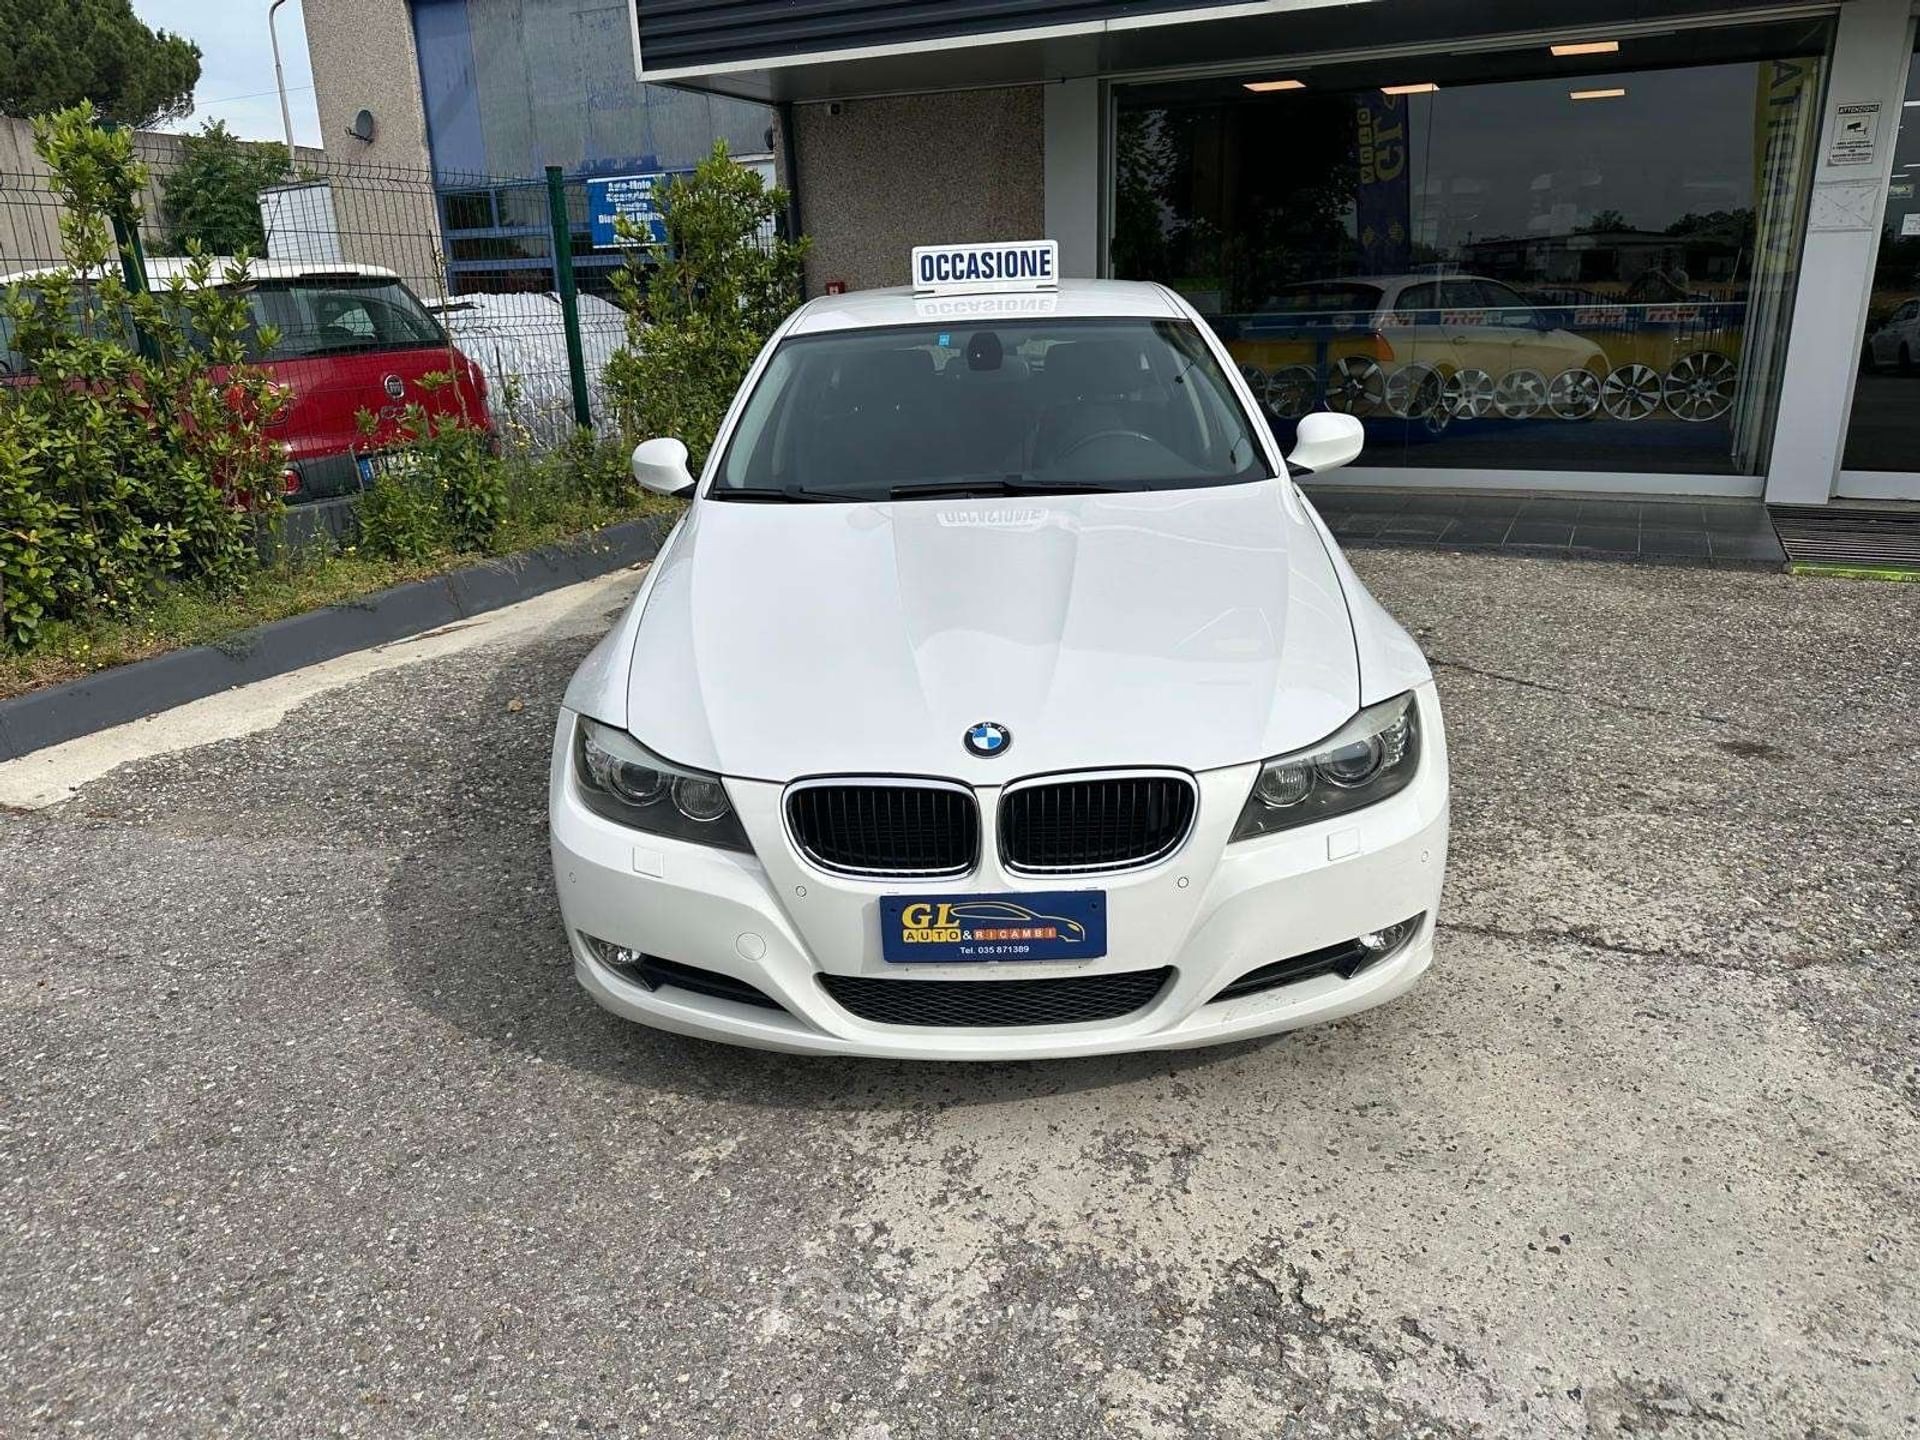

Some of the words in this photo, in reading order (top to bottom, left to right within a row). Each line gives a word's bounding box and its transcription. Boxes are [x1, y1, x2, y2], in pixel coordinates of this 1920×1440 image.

[921, 249, 1051, 282] OCCASIONE
[902, 903, 960, 928] GL
[904, 930, 960, 942] AUTO
[962, 930, 972, 940] &
[975, 928, 1054, 940] RICAMBI
[960, 946, 976, 954] Tel.
[978, 946, 995, 954] 035
[996, 945, 1030, 953] 871389
